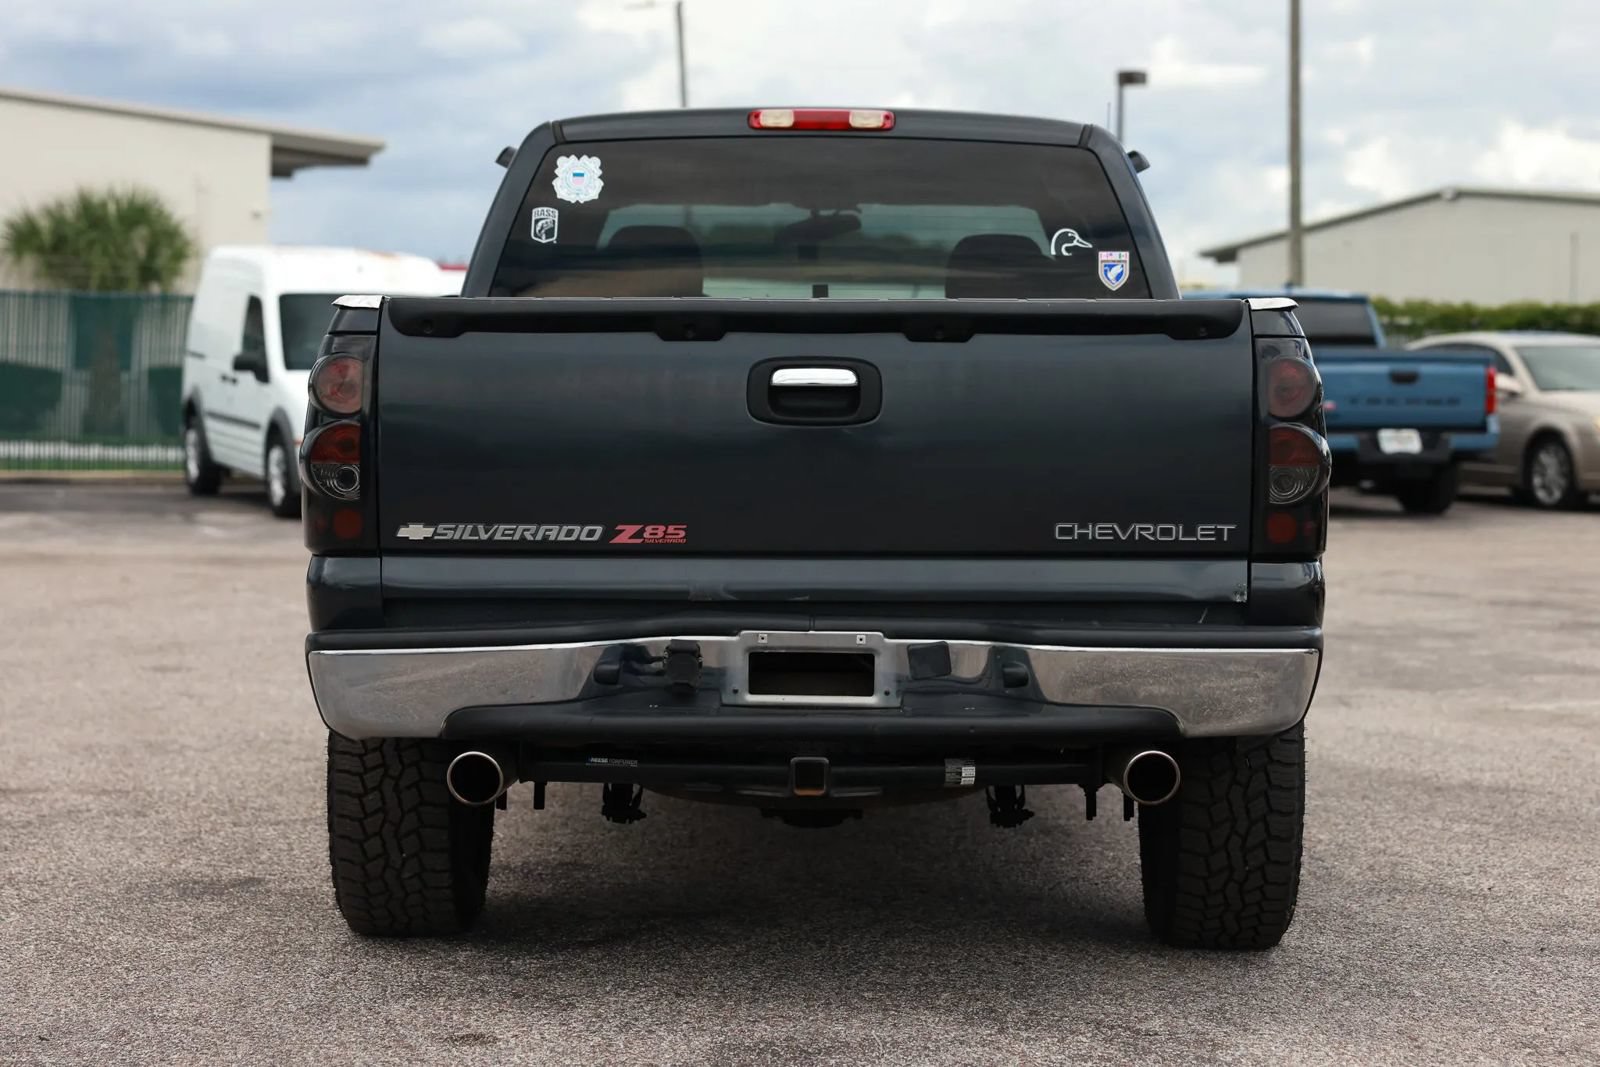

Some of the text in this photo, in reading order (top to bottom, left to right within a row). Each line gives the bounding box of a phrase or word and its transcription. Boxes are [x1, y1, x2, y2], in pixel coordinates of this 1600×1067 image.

[433, 524, 688, 543] SILVERADO Z85
[1055, 524, 1237, 541] CHEVROLET
